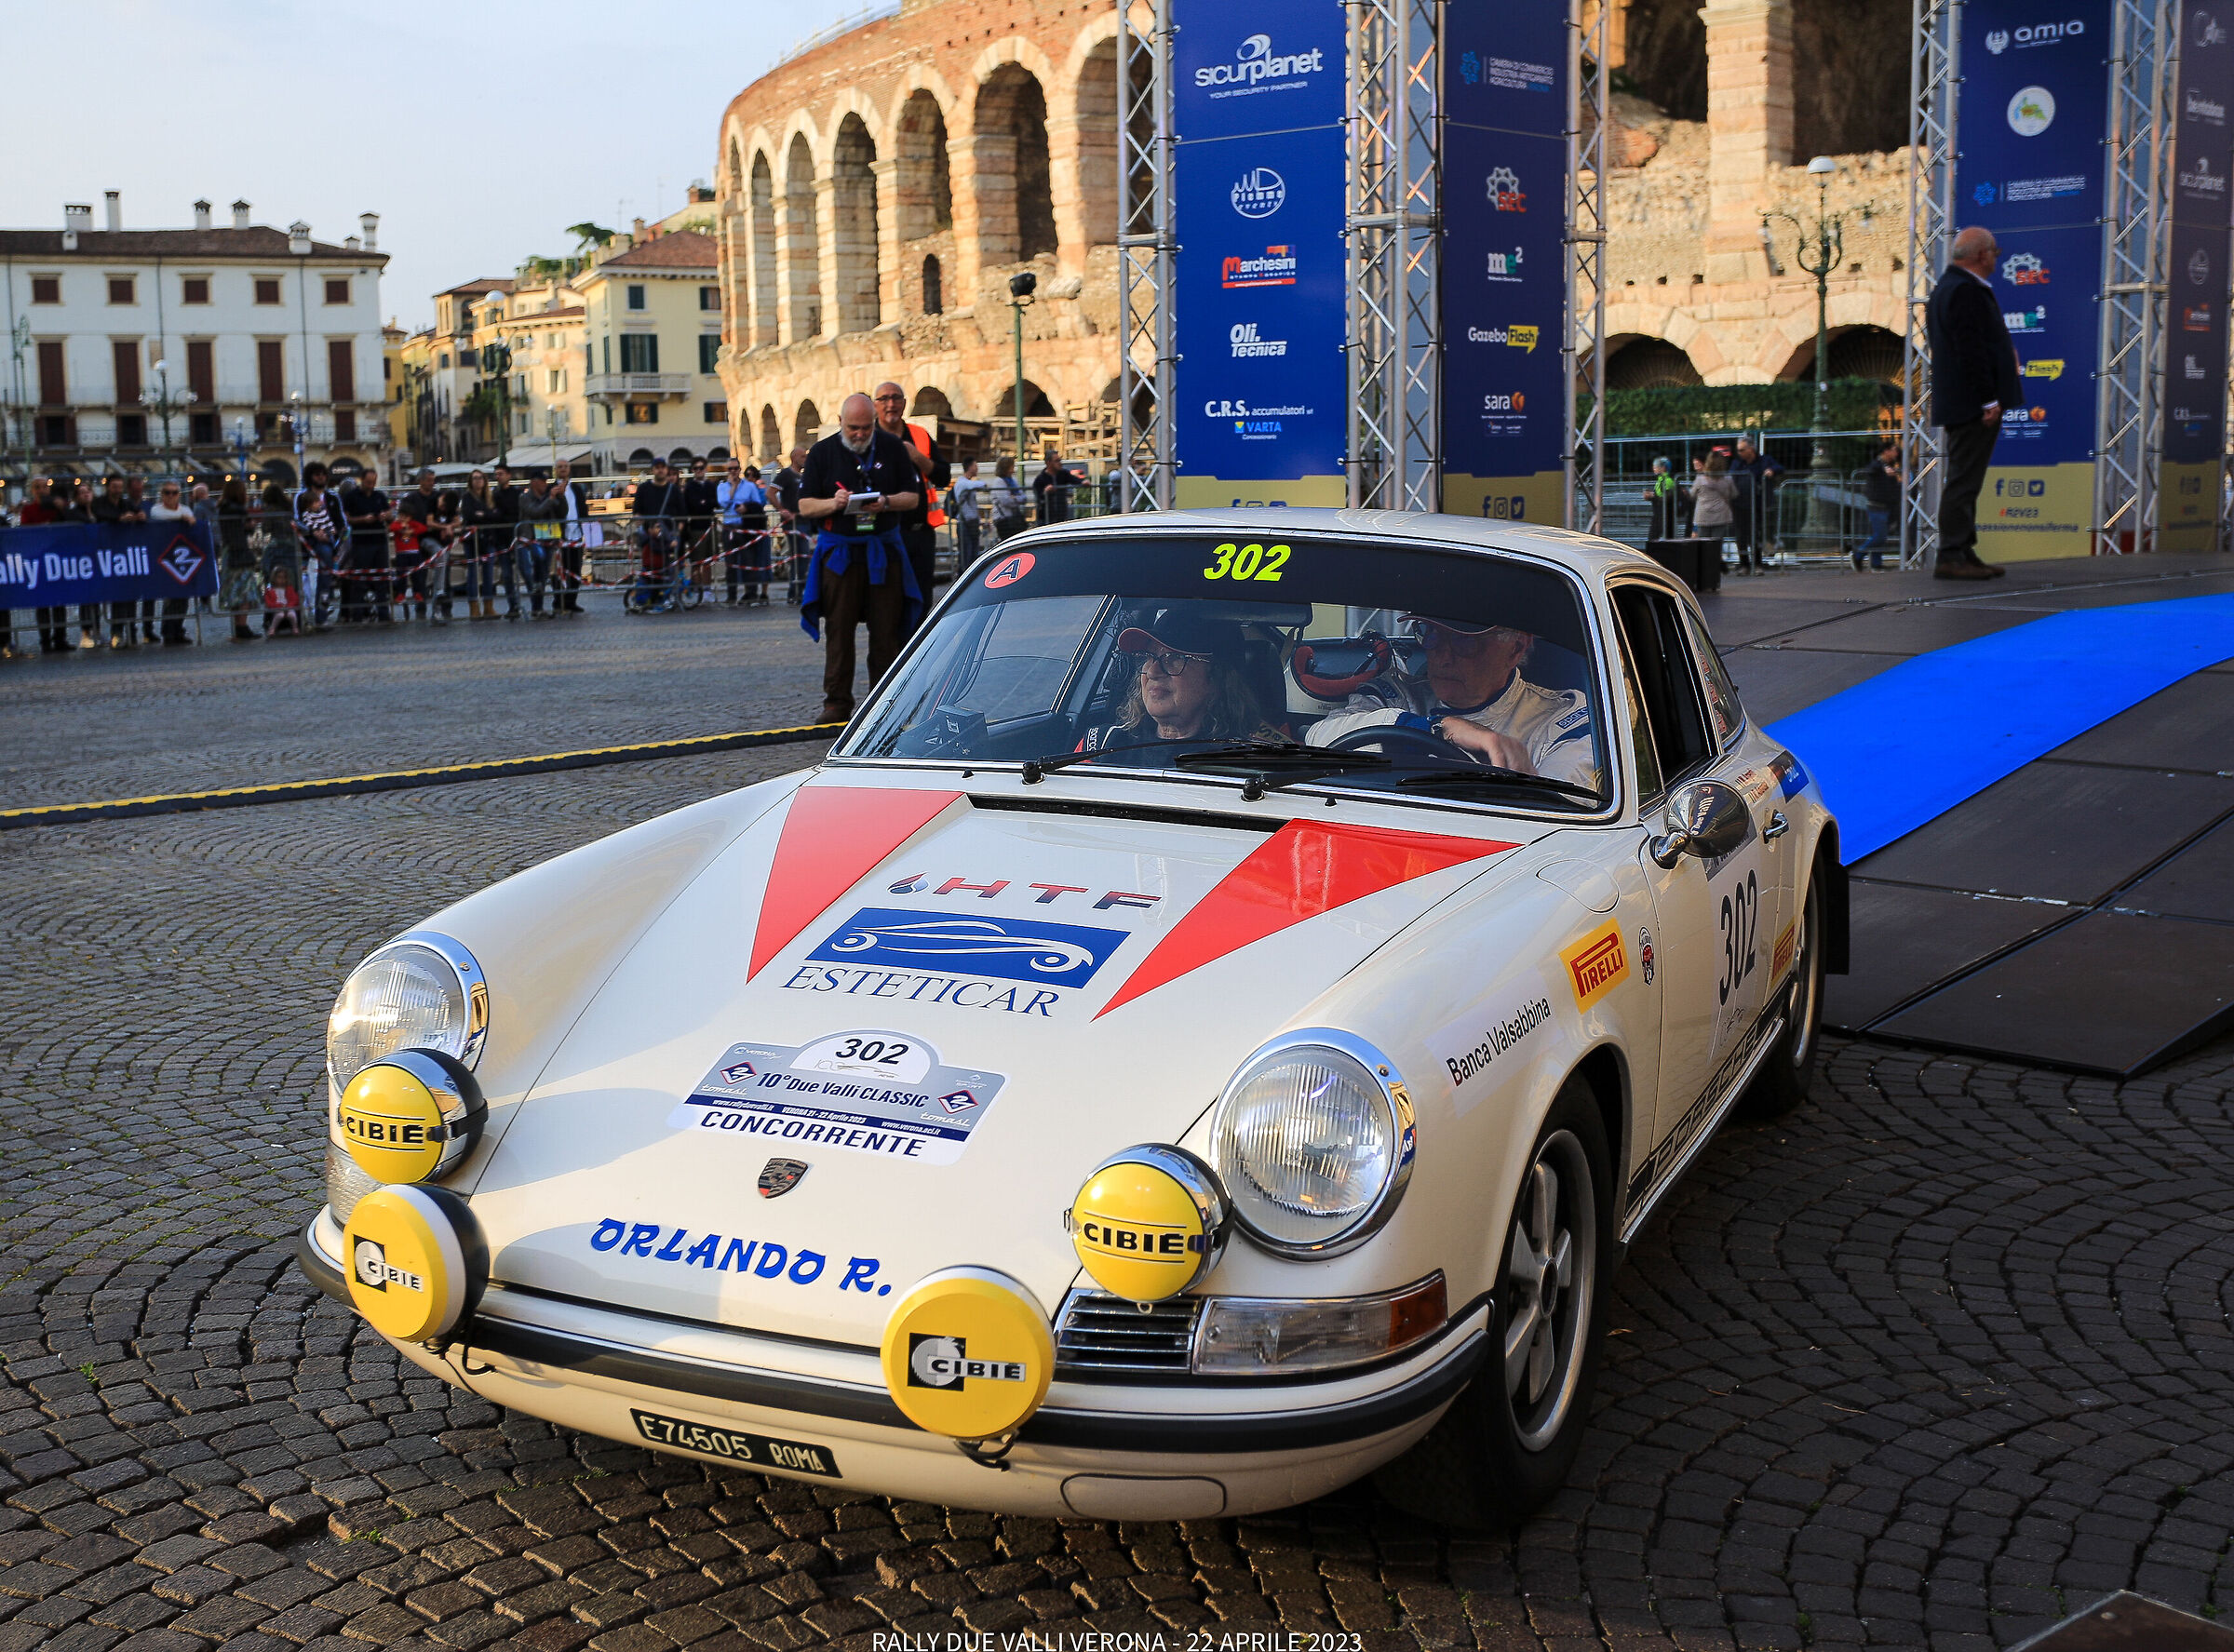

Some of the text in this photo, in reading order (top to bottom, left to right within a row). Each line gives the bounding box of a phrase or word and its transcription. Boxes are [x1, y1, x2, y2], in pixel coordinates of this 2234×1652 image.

[1194, 47, 1324, 87] sicurplanet
[1498, 191, 1527, 212] SEC
[1222, 256, 1297, 280] Marchesini
[2015, 269, 2051, 286] SEC
[1230, 323, 1261, 343] Oli.
[1231, 341, 1288, 358] Tecnica
[1204, 399, 1250, 418] C.R.S.
[1251, 405, 1305, 416] accumulatori
[1485, 395, 1510, 410] sara
[1246, 422, 1283, 433] VARTA
[44, 552, 94, 582] Due
[97, 545, 150, 578] Valli
[990, 557, 1022, 584] A
[1204, 543, 1292, 582] 302
[932, 877, 1163, 910] HTF
[1719, 869, 1757, 1006] 302
[1570, 932, 1625, 999] PIRELLI
[779, 965, 1061, 1018] ESTETICAR
[835, 1038, 909, 1065] 302
[1446, 996, 1552, 1087] Banca Valsabbina
[786, 1078, 820, 1093] Due
[821, 1081, 860, 1098] Valli
[859, 1087, 930, 1108] CLASSIC
[1650, 1022, 1758, 1181] PORSCHE
[781, 1106, 808, 1117] VERONA
[699, 1110, 928, 1158] CONCORRENTE
[590, 1217, 892, 1296] ORLANDO R.
[639, 1415, 827, 1472] E74505 ROMA
